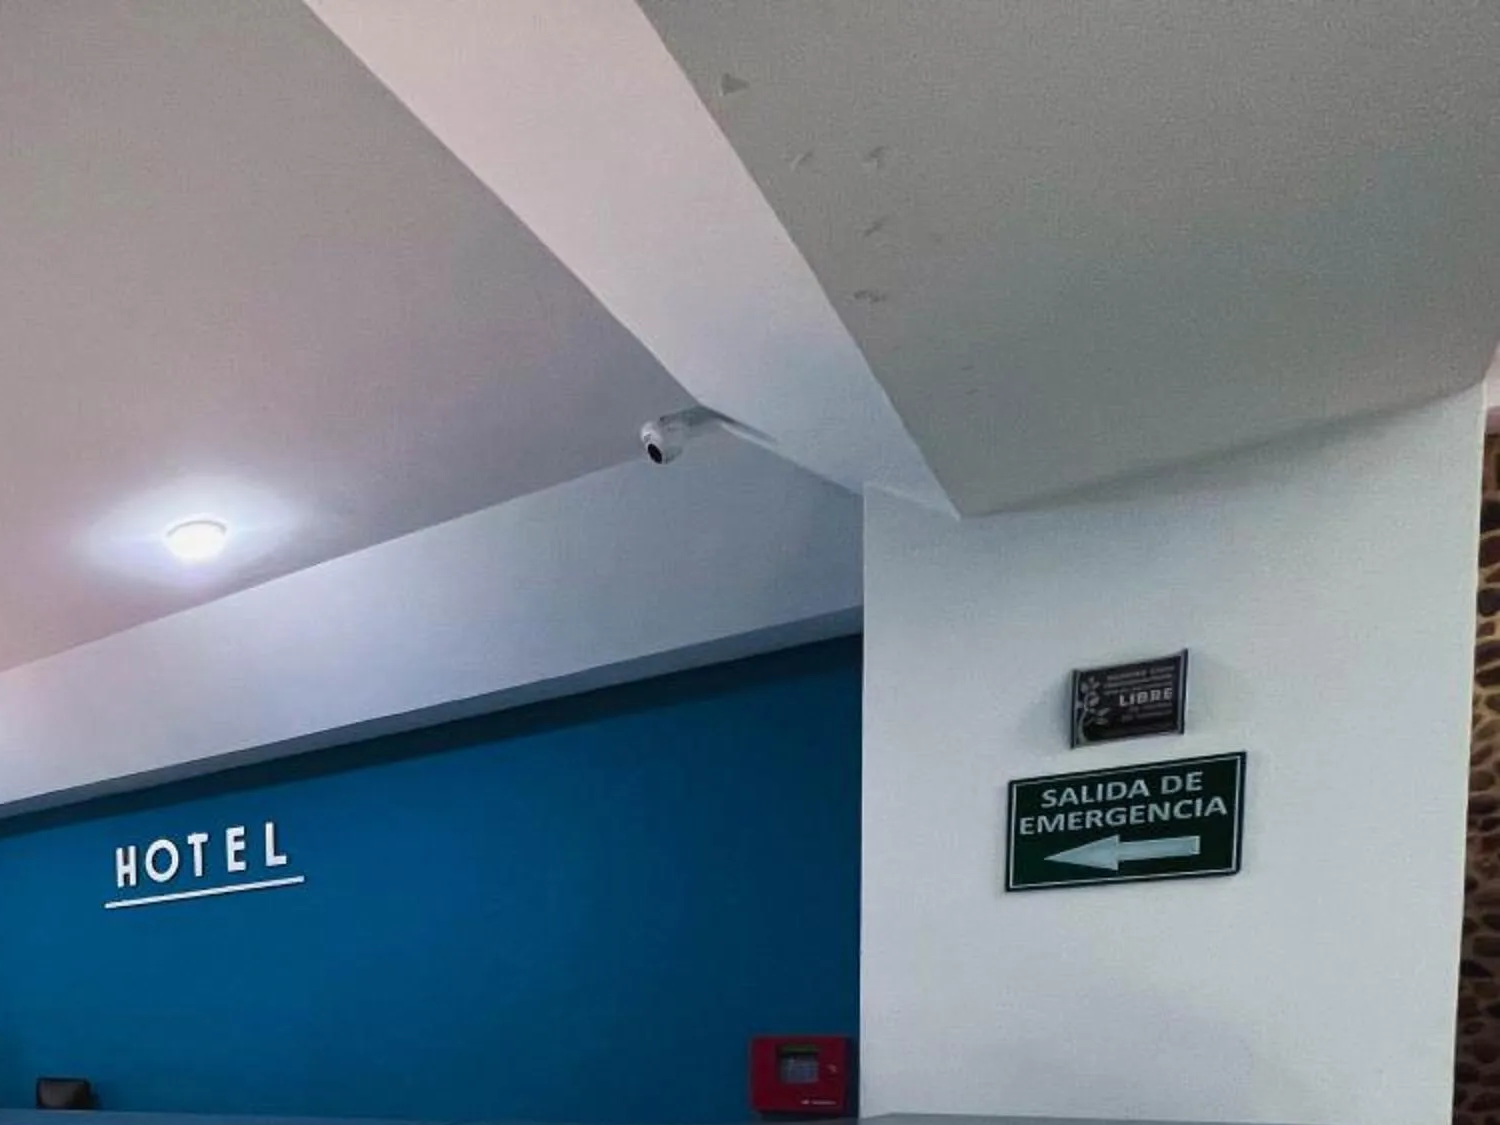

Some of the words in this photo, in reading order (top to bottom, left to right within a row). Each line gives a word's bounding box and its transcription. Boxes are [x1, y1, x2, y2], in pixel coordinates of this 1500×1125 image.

[1119, 687, 1173, 707] LIBRE
[1040, 779, 1150, 808] SALIDA
[1160, 771, 1204, 795] DE
[1019, 796, 1228, 835] EMERGENCIA
[115, 821, 287, 888] HOTEL
